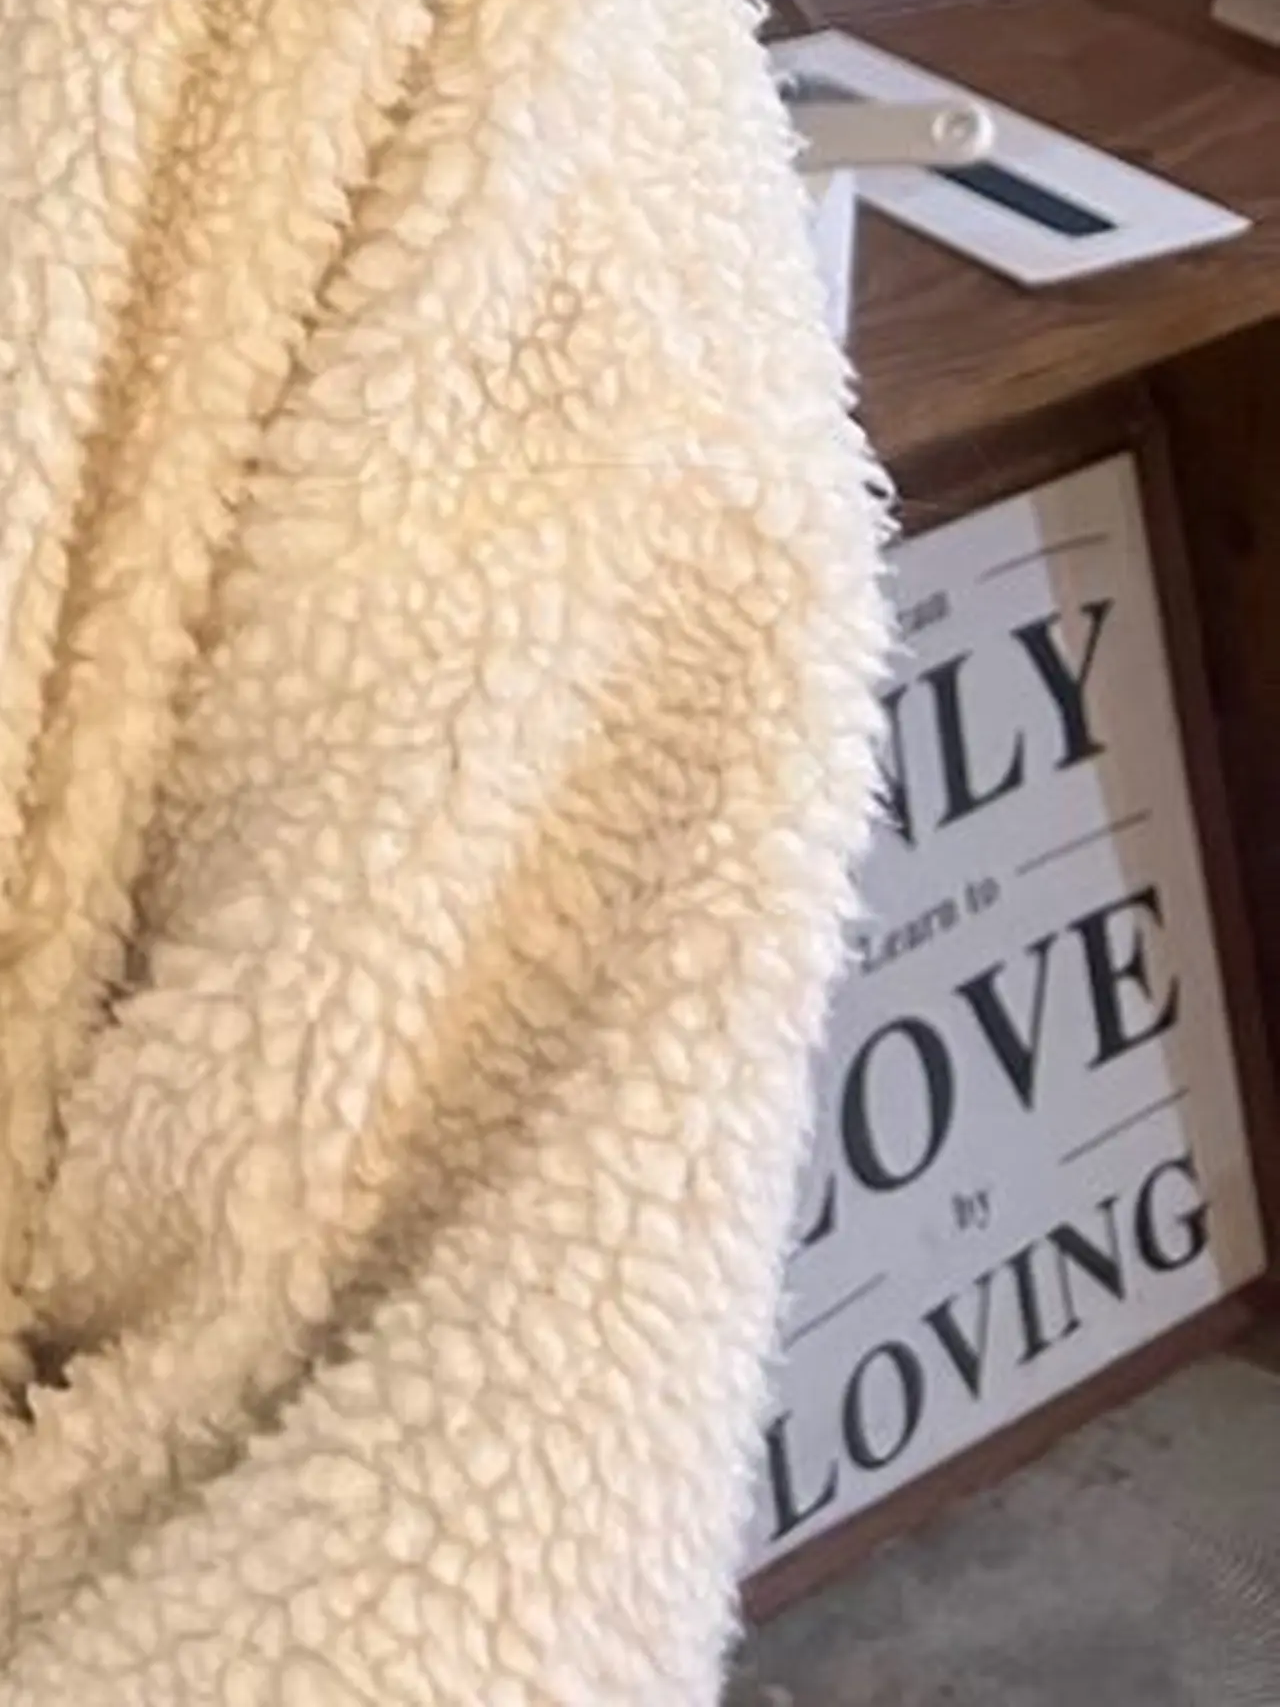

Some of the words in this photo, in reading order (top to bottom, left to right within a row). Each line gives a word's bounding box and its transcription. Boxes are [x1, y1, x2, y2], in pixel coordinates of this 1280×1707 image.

[858, 897, 960, 975] Learn
[965, 877, 1001, 915] to
[790, 883, 1181, 1263] OVE
[952, 1189, 991, 1231] by
[765, 1155, 1210, 1543] LOVING
